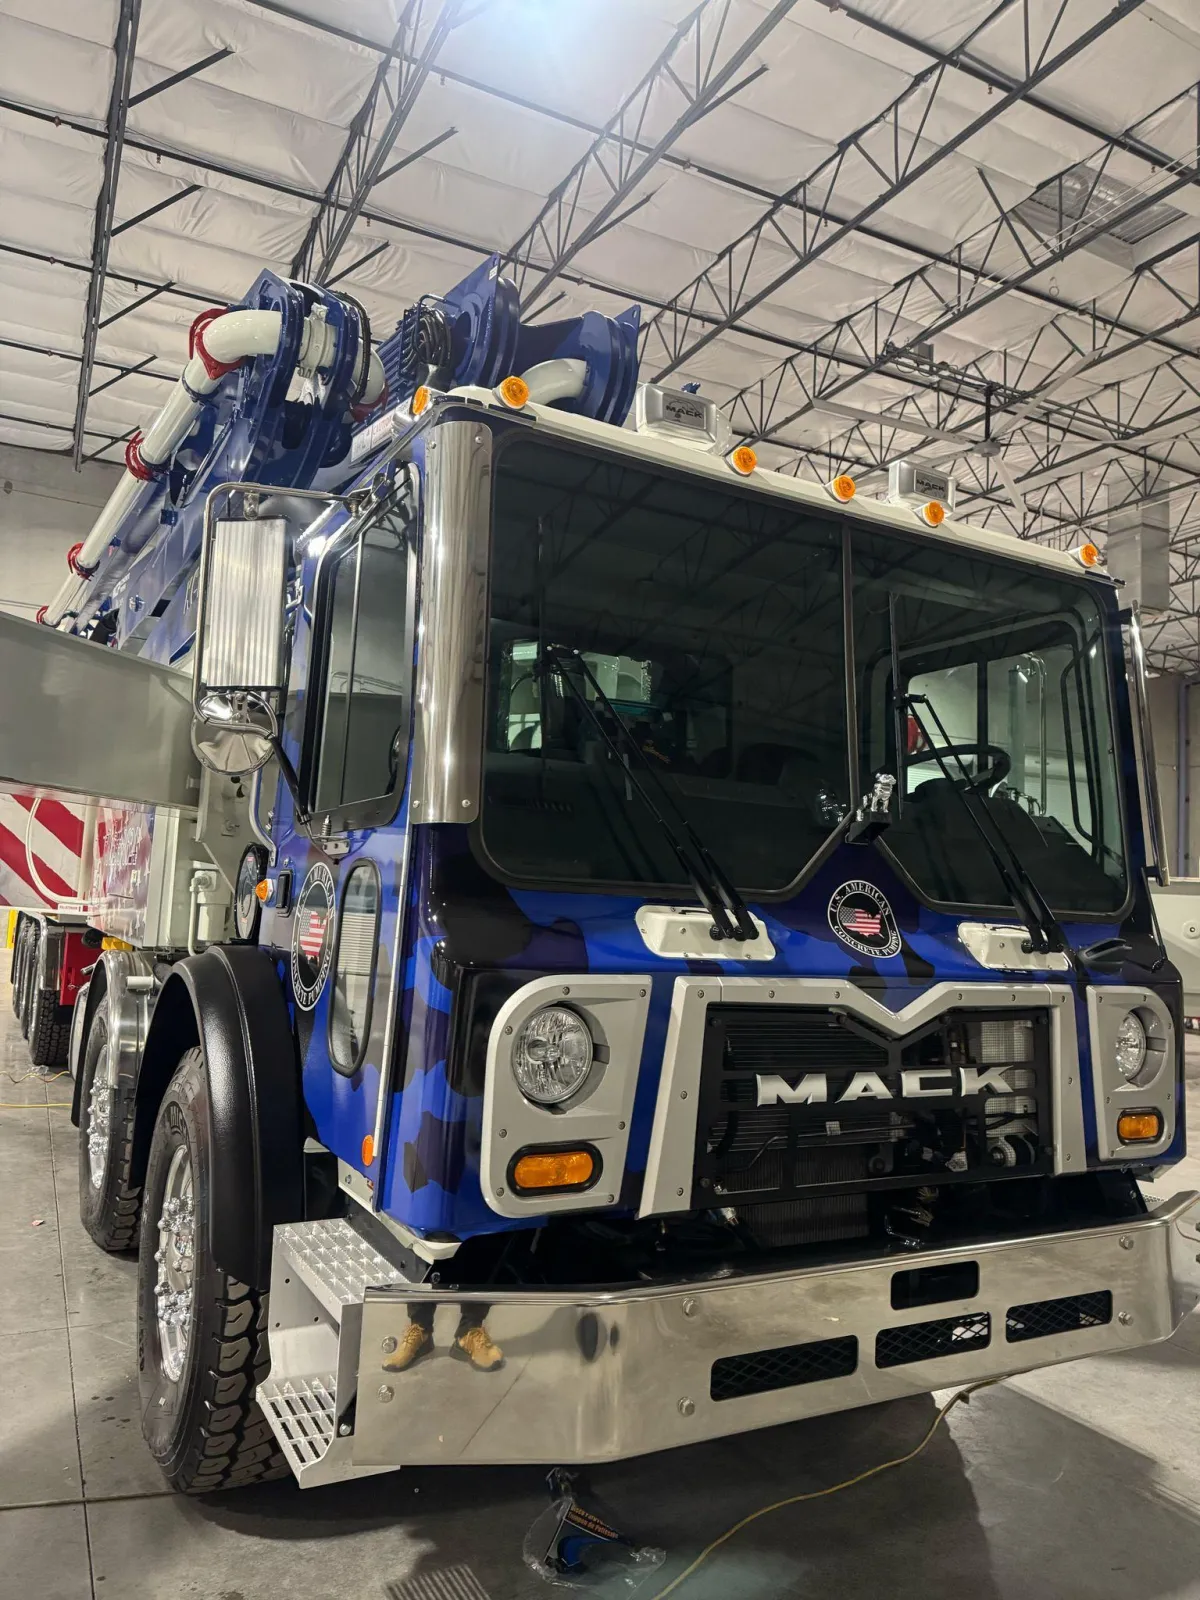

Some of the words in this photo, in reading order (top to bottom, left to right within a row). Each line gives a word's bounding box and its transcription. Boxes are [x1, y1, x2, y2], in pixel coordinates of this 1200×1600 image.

[665, 404, 703, 419] MACK
[916, 479, 945, 492] MACK
[830, 893, 844, 913] U.S.
[845, 882, 891, 916] AMERICAN
[834, 925, 882, 956] CONCRETE
[882, 929, 899, 956] PUMPING
[755, 1064, 1014, 1107] MACK
